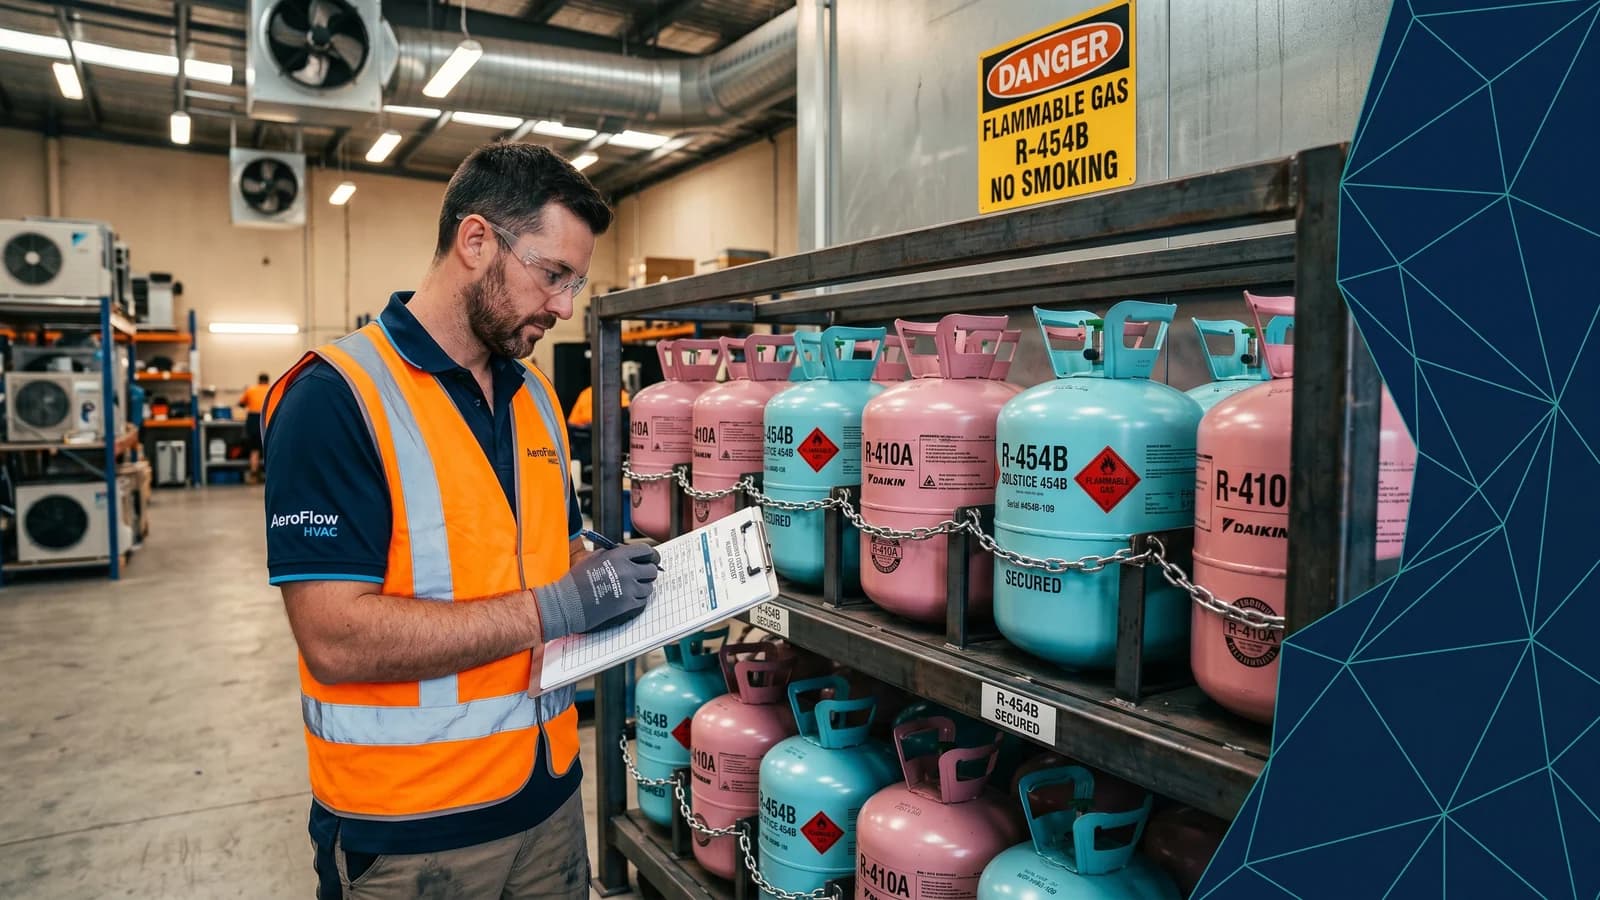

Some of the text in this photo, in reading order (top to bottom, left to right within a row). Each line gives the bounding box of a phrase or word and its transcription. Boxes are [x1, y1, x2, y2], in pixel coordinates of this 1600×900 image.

[998, 29, 1109, 93] DANGER
[983, 77, 1128, 142] FLAMMABLE GAS
[1016, 121, 1089, 165] R-454B
[991, 149, 1118, 204] NO SMOKING
[865, 441, 913, 466] R-410A
[1002, 442, 1068, 472] R-454B
[873, 477, 906, 487] DAIKIN
[1002, 472, 1067, 490] SOLSTICE 454B
[1086, 476, 1129, 486] FLAMMABLE
[1216, 469, 1287, 508] R-410
[270, 510, 339, 528] AeroFlow
[304, 527, 338, 537] HVAC
[872, 543, 898, 557] R-410A
[1005, 569, 1061, 593] SECURED
[756, 615, 781, 632] SECURED
[1228, 621, 1277, 643] R-410A
[997, 691, 1039, 718] R-454B
[995, 708, 1040, 735] SECURED
[861, 852, 910, 898] R-410A
